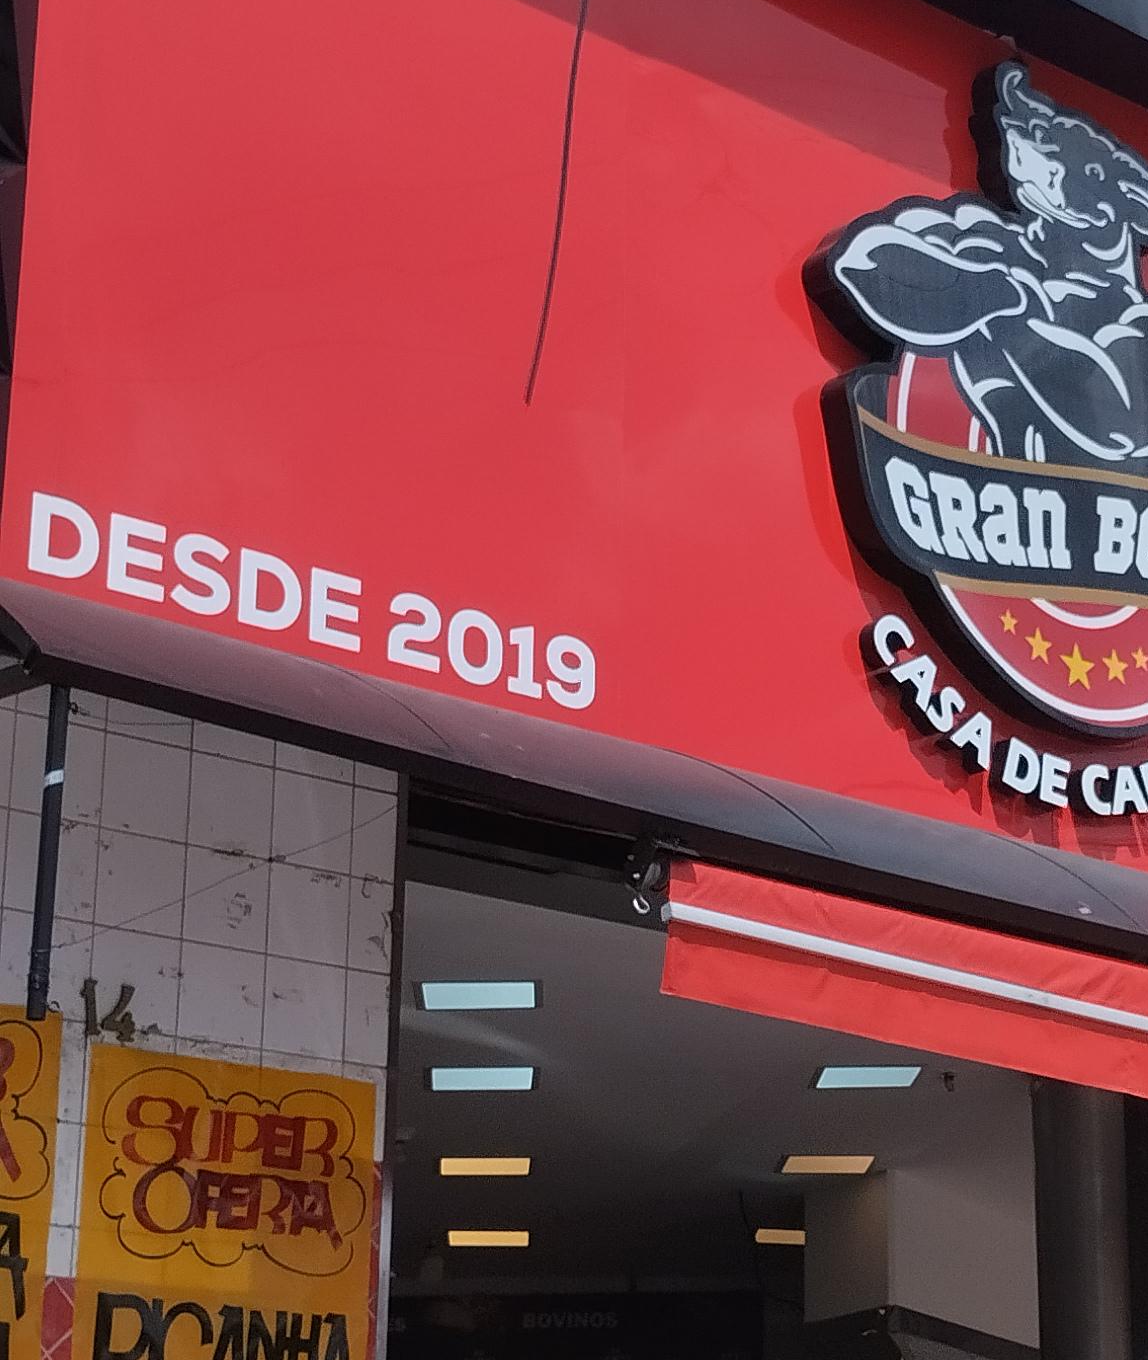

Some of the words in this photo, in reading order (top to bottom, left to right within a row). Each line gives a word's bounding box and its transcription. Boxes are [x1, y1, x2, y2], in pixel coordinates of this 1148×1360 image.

[27, 492, 363, 654] DESDE
[387, 592, 597, 711] 2019
[872, 612, 991, 771] CASA
[1002, 737, 1071, 808] DE
[121, 1095, 340, 1178] SUPER
[131, 1159, 345, 1251] OFERTA
[521, 1311, 620, 1329] BOVINOS
